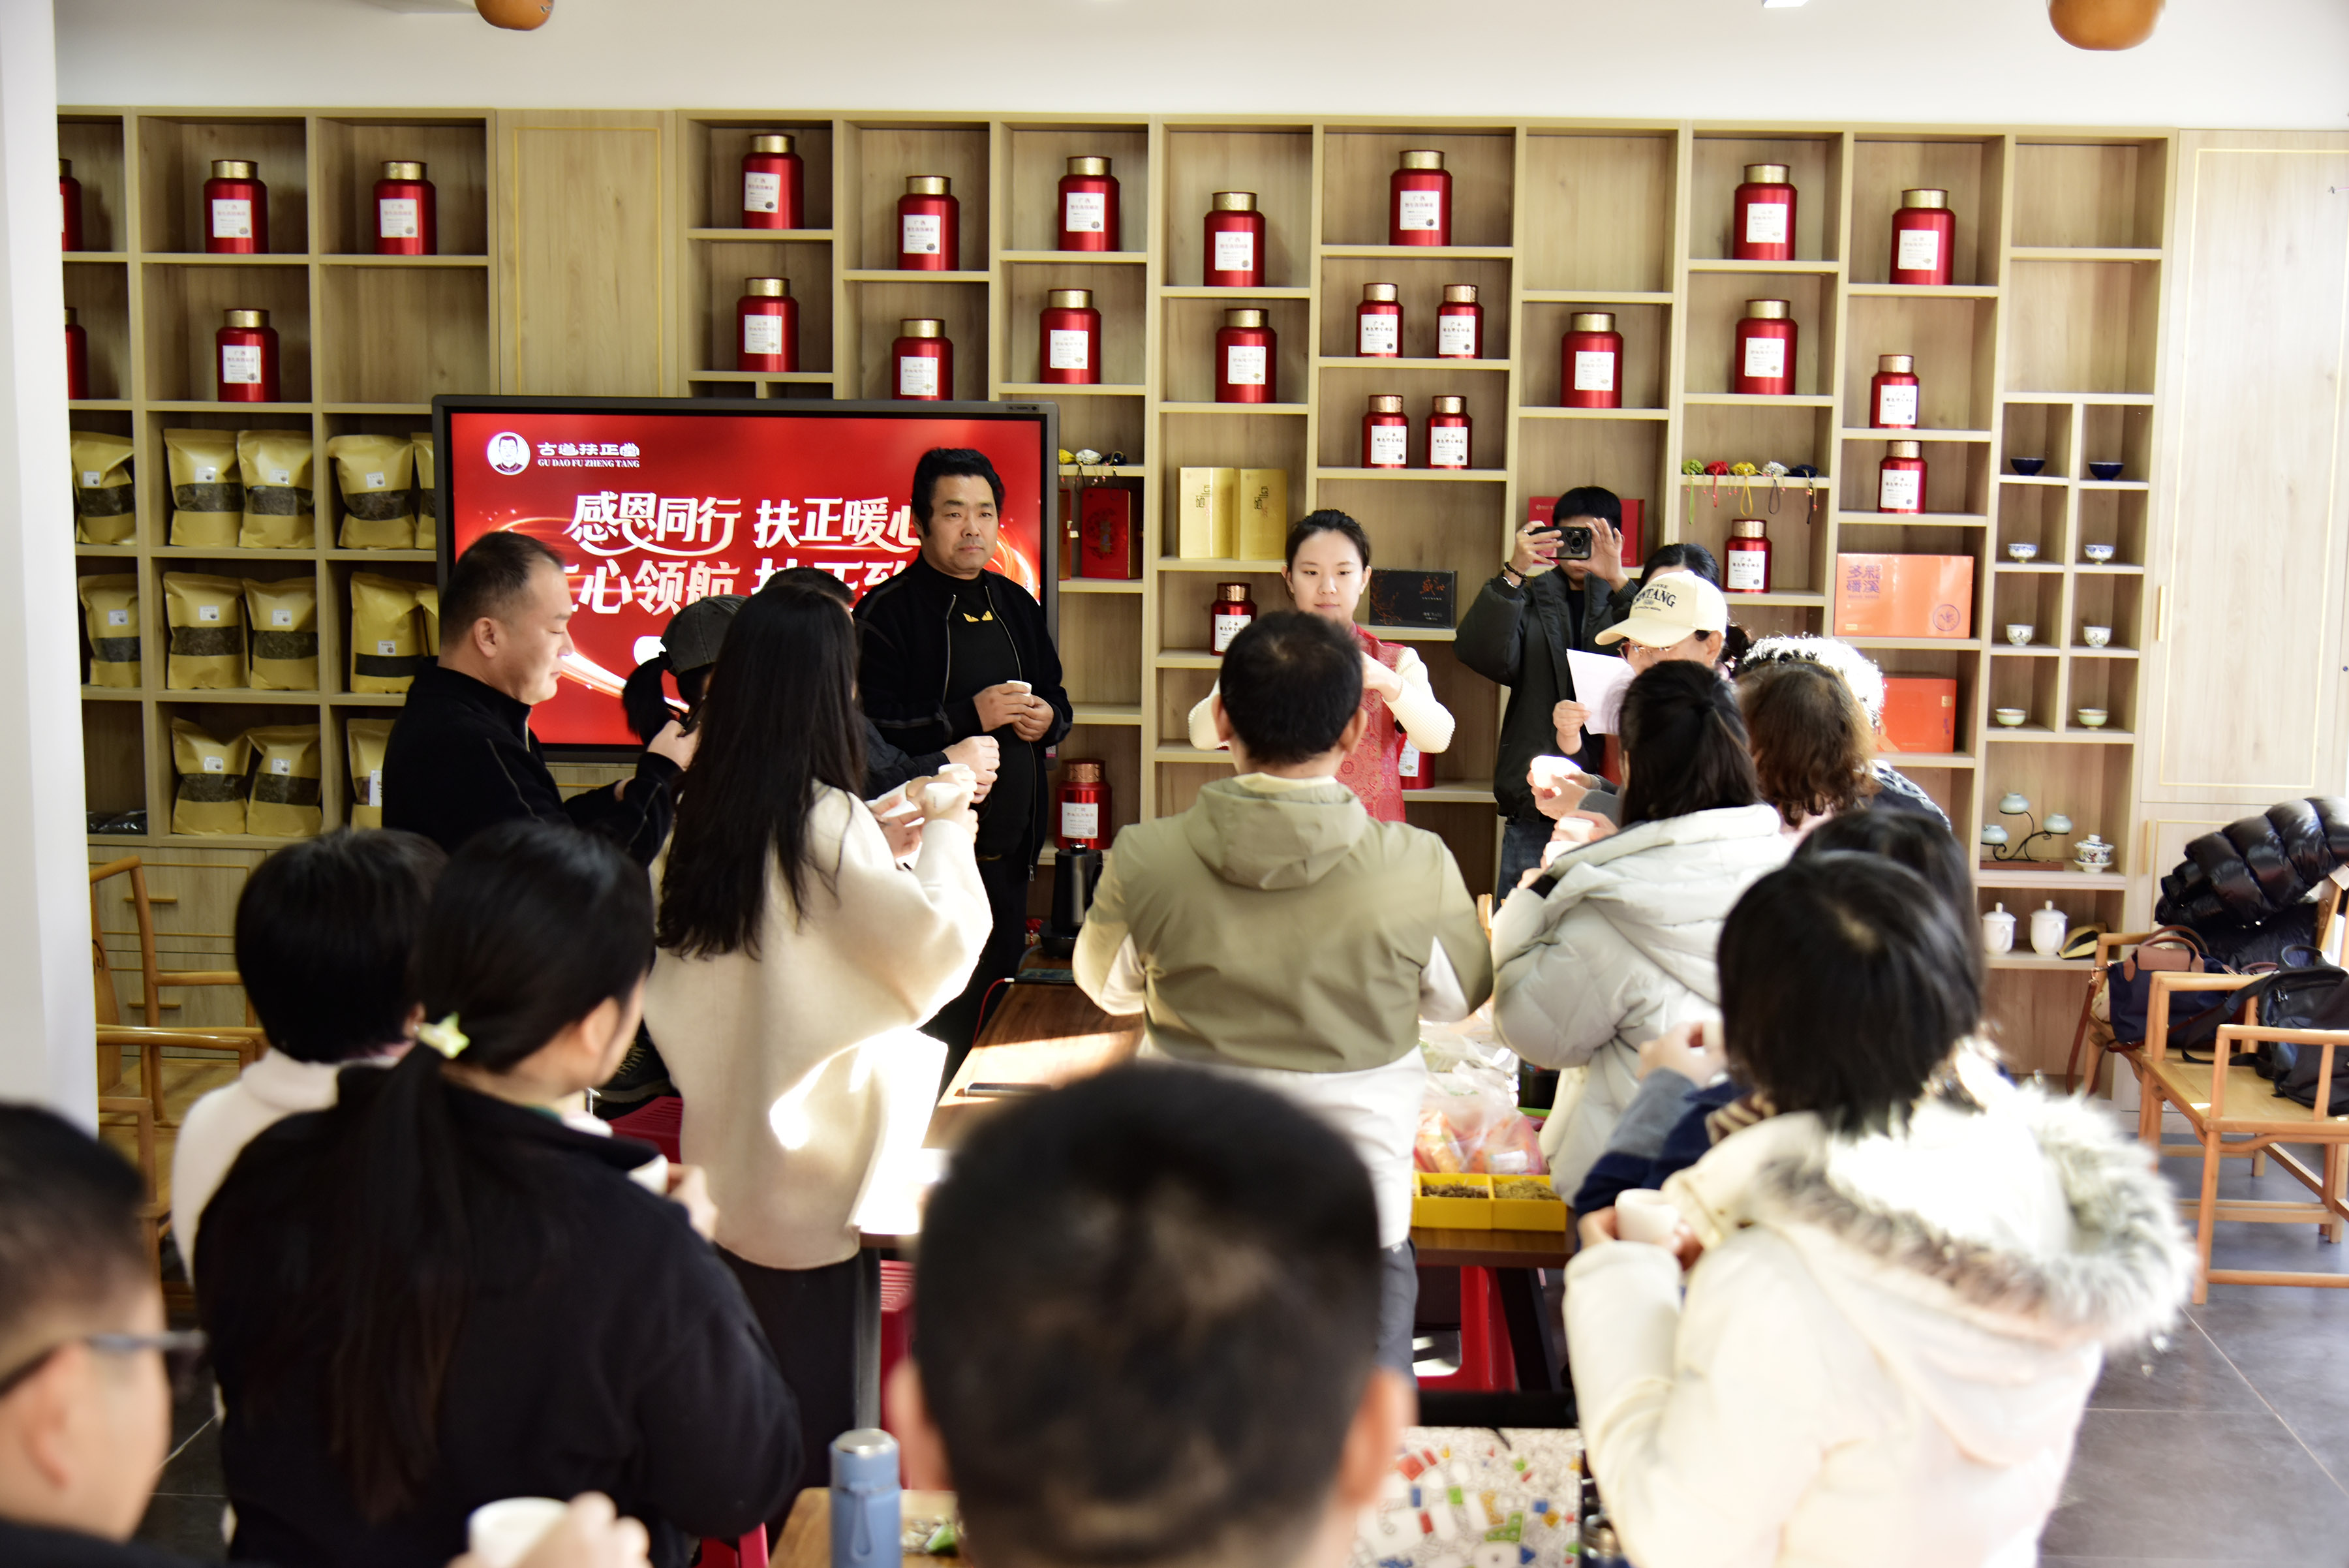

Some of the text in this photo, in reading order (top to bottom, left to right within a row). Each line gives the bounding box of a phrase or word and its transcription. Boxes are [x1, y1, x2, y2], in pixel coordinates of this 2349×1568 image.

[537, 442, 640, 457] 古道扶正堂
[537, 459, 640, 468] GU DAO FU ZHENG TANG
[562, 491, 742, 557] 感恩同行
